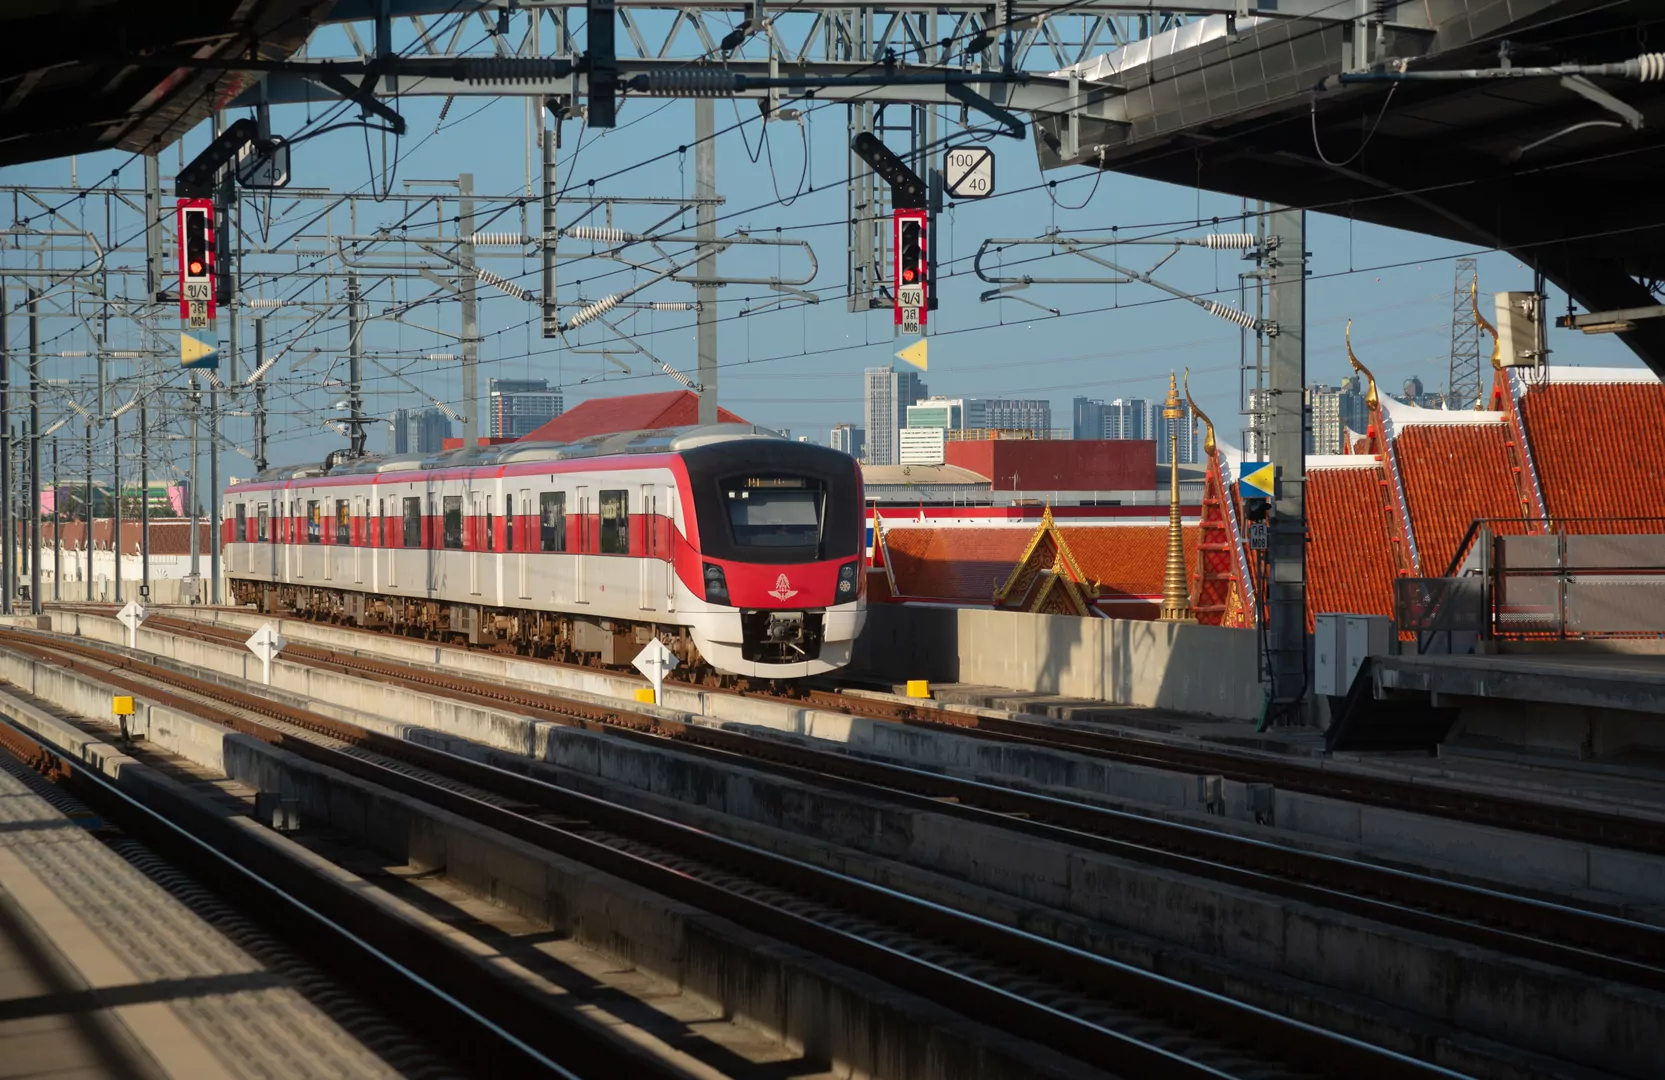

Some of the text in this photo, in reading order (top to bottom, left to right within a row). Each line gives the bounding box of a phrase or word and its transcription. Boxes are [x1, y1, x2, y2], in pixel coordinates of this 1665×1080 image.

[949, 154, 973, 167] 100
[263, 168, 281, 181] 40
[969, 178, 986, 191] 40
[191, 317, 206, 327] M04
[904, 322, 918, 332] M06
